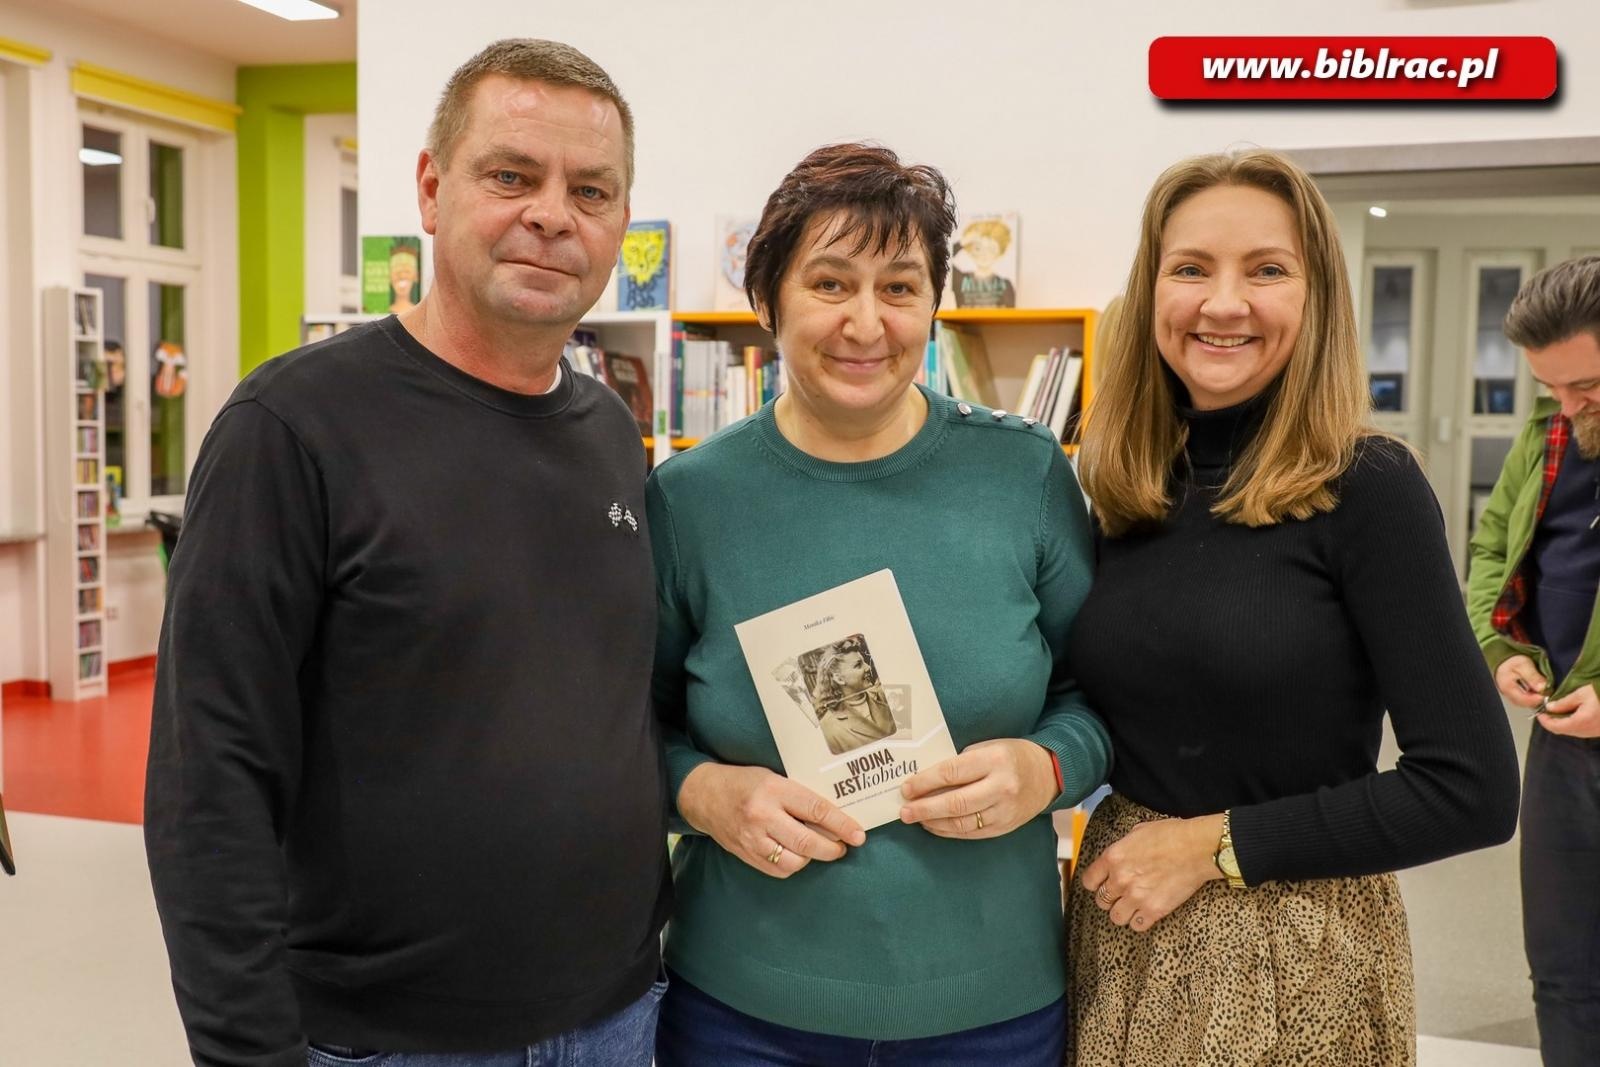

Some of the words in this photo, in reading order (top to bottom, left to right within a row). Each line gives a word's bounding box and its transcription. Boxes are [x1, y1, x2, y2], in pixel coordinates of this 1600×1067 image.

[846, 748, 895, 776] WOJNA
[833, 776, 862, 799] JEST
[861, 760, 918, 789] kobietą
